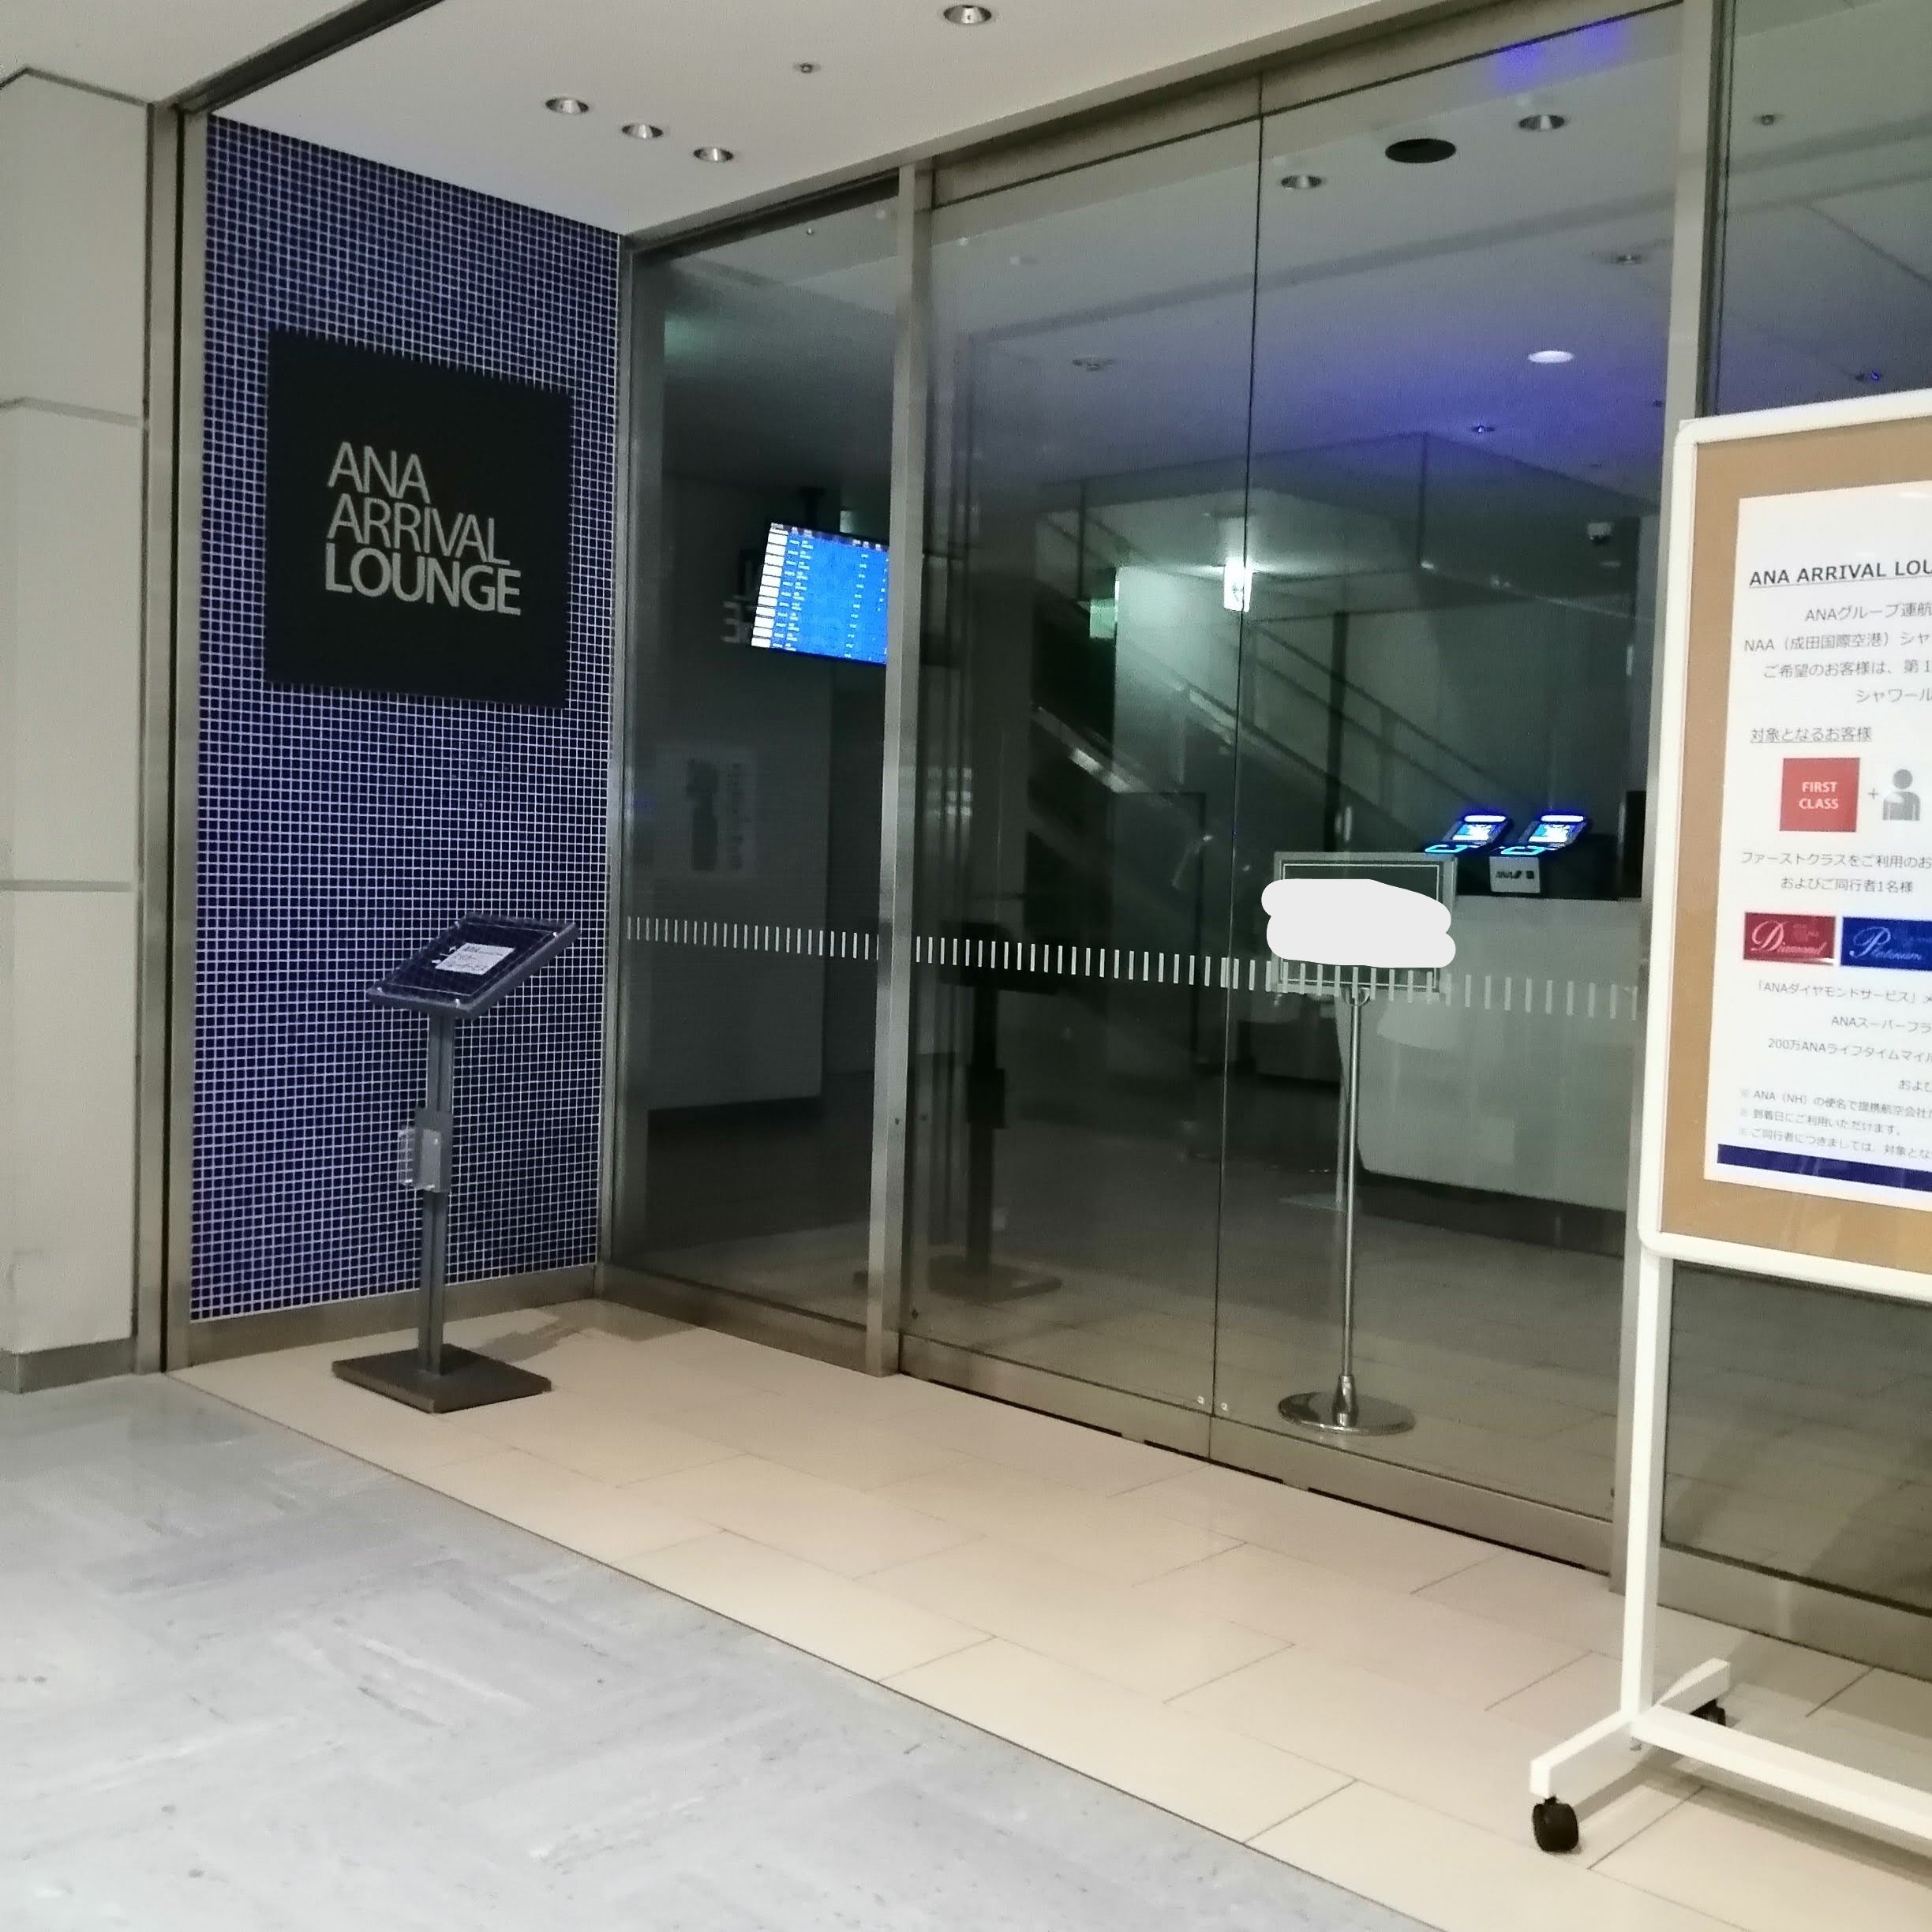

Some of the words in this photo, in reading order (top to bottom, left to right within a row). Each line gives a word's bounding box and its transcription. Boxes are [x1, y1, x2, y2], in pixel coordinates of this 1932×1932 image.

[328, 442, 431, 504] ANA
[328, 493, 511, 565] ARRIVAL
[325, 543, 521, 616] LOUNGE
[1750, 569, 1790, 586] ANA
[1796, 563, 1886, 583] ARRIVAL
[1750, 726, 1873, 743] 対象となるお客様
[1802, 781, 1837, 793] FIRST
[1799, 798, 1839, 810] CLASS
